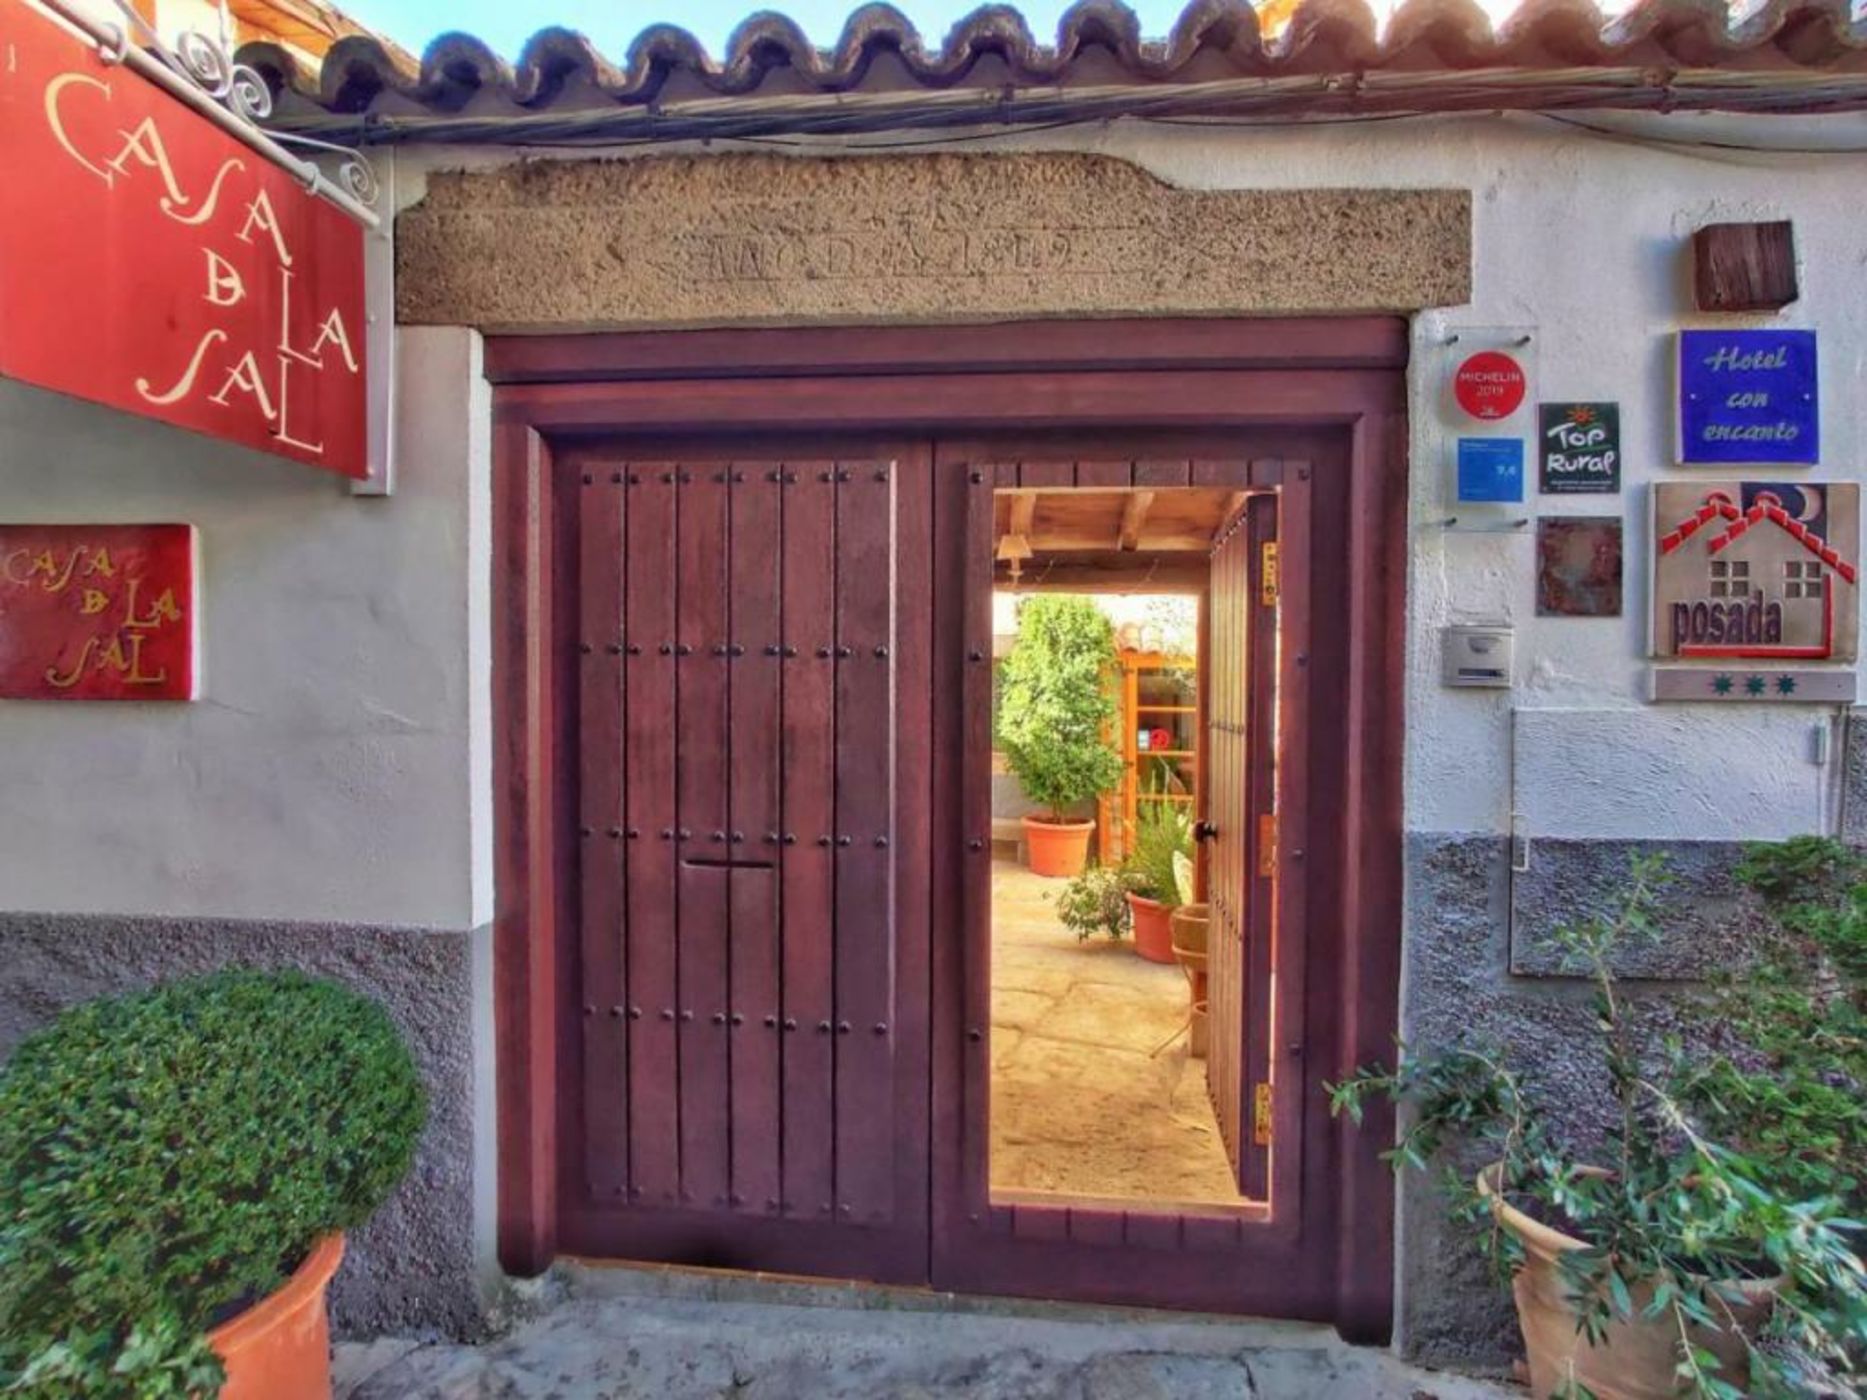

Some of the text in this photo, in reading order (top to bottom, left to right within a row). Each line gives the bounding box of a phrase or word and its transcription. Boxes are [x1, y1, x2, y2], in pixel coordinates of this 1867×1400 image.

[44, 72, 293, 267] CASA
[276, 266, 358, 372] LA
[1460, 371, 1520, 383] MICHELIN
[1703, 346, 1788, 372] Hotel
[134, 328, 323, 453] SAL
[1726, 392, 1769, 408] con
[1703, 422, 1799, 442] encanto
[1547, 451, 1615, 476] Rural
[3, 544, 115, 592] CASA
[120, 578, 183, 628] LA
[1673, 589, 1783, 656] posada
[45, 634, 166, 688] SAL
